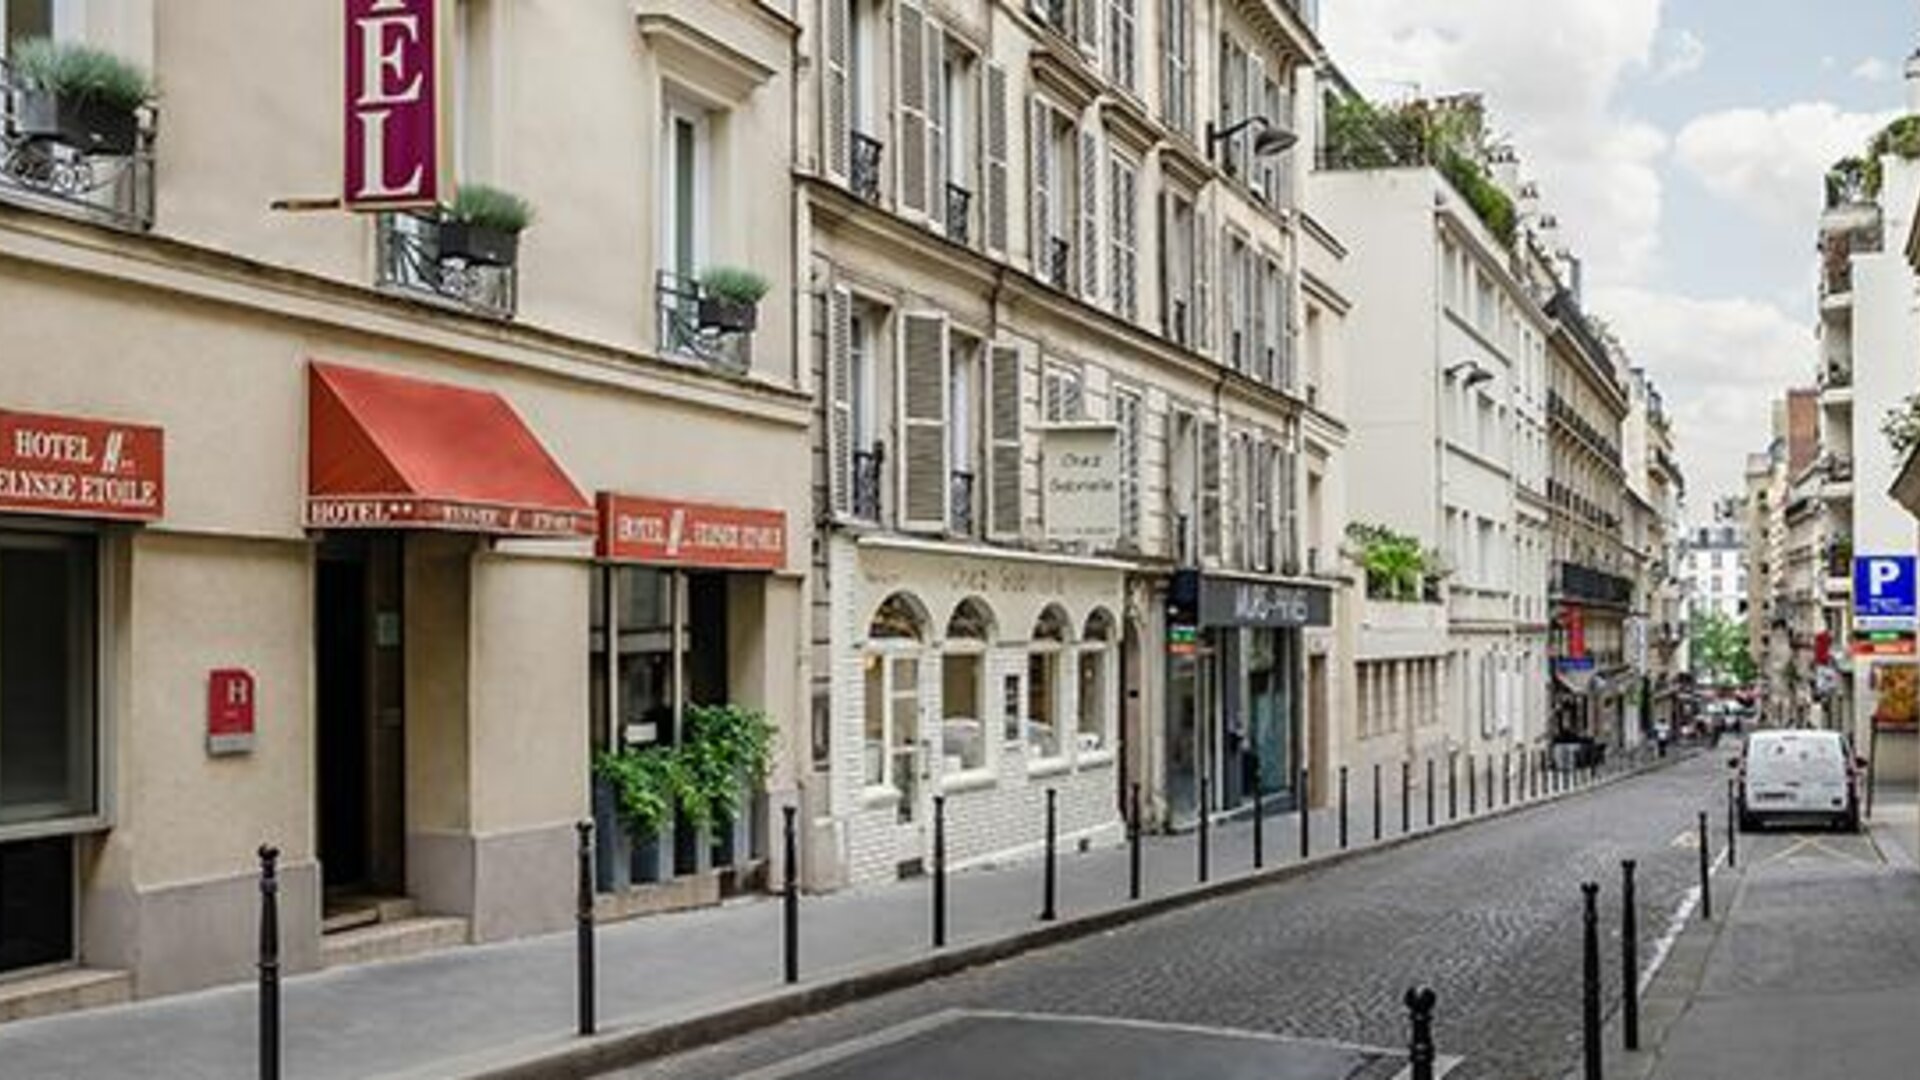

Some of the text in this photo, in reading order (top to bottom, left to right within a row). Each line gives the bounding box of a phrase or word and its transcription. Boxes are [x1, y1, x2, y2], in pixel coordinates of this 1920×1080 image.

[355, 0, 424, 199] EL
[14, 429, 94, 464] HOTEL
[81, 475, 157, 507] ETOILE
[1869, 560, 1901, 596] P
[227, 679, 249, 705] H
